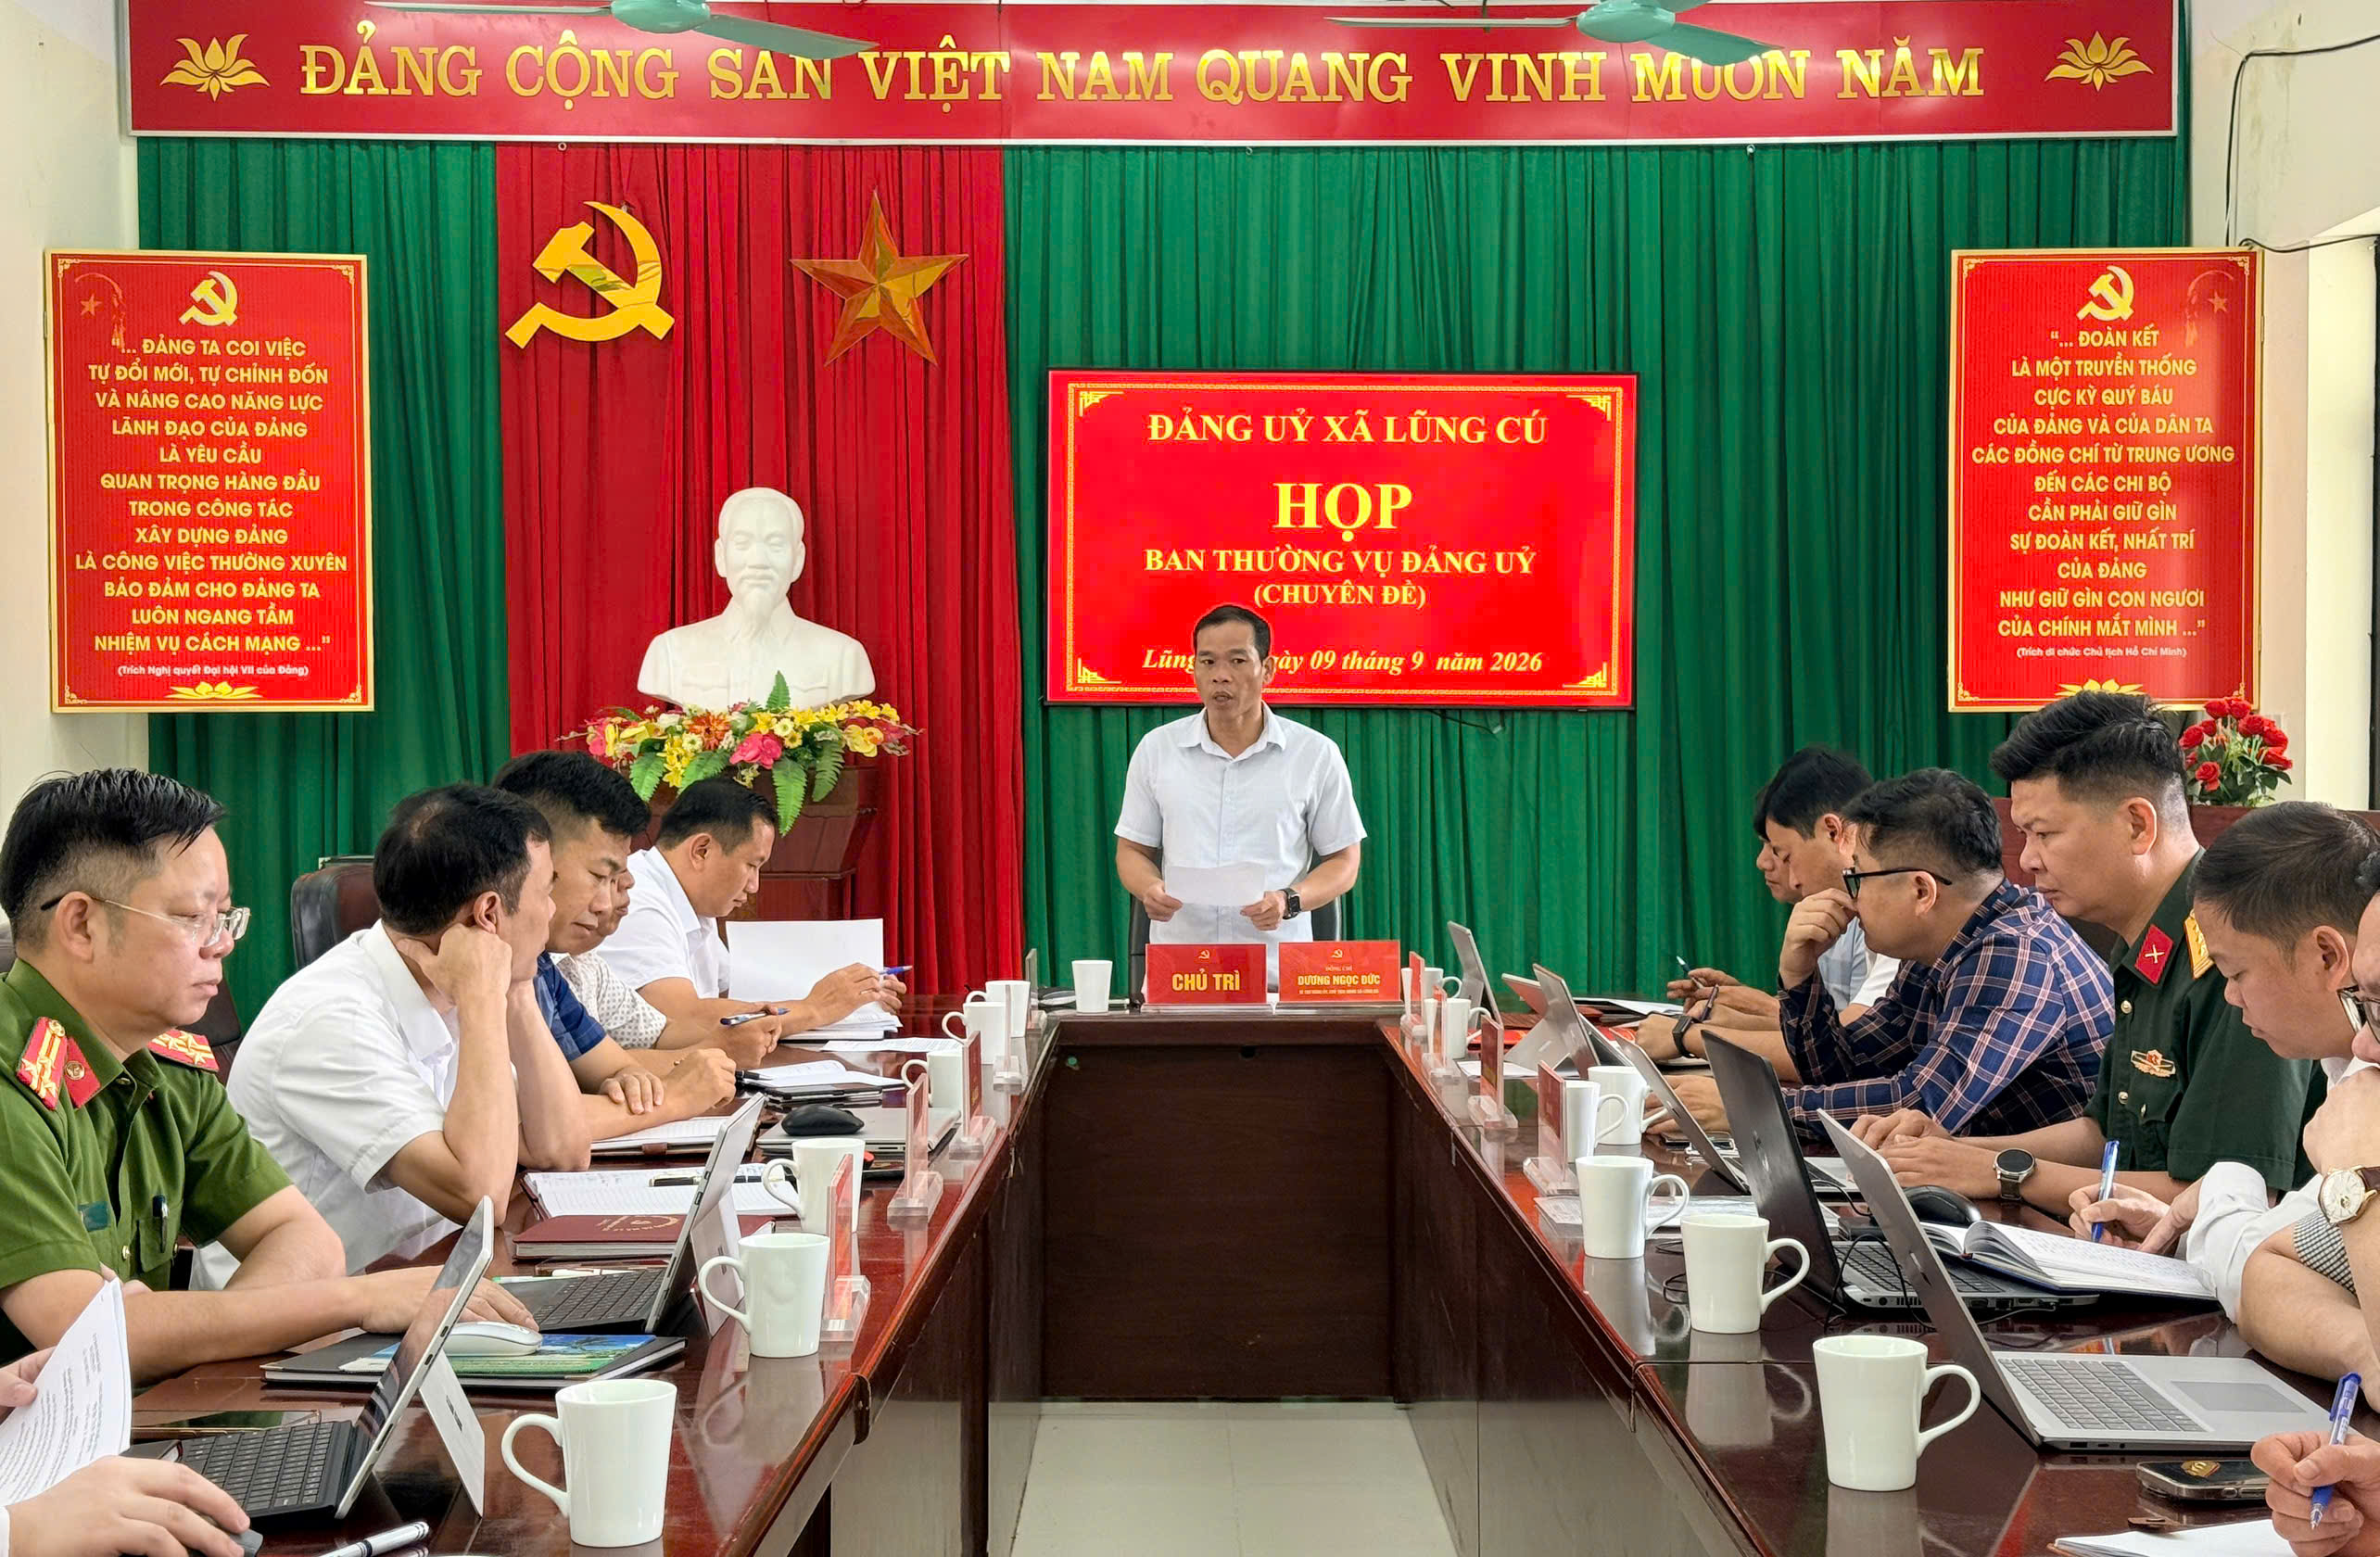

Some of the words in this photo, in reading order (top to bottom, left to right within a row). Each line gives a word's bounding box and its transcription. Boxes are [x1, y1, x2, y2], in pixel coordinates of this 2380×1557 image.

[299, 19, 483, 97] ĐẢNG
[506, 29, 678, 110] CỘNG
[858, 35, 1010, 113] VIỆT
[1036, 52, 1173, 101] NAM
[1196, 48, 1412, 106] QUANG
[1439, 52, 1607, 102] VINH
[1836, 36, 1984, 97] NĂM
[2079, 326, 2127, 347] ĐOÀN
[2133, 323, 2159, 347] KẾT
[142, 334, 196, 355] ĐẢNG
[200, 340, 221, 355] TA
[226, 341, 260, 356] COI
[265, 337, 305, 361] VIỆC
[89, 363, 110, 385] TỰ
[115, 358, 147, 381] ĐỔI
[154, 362, 193, 385] MỚI,
[199, 365, 221, 386] TỰ
[225, 363, 283, 383] CHỈNH
[288, 362, 327, 384] ĐỐN
[2012, 356, 2031, 376] LÀ
[2036, 356, 2071, 381] MỘT
[2076, 352, 2133, 376] TRUYỀN
[2139, 353, 2196, 375] THỐNG
[95, 388, 120, 407] VÀ
[127, 389, 179, 408] NÂNG
[185, 394, 225, 409] CAO
[232, 391, 284, 410] NĂNG
[290, 393, 323, 414] LỰC
[2034, 387, 2070, 410] CỰC
[2076, 385, 2097, 405] KỲ
[2102, 385, 2135, 405] QUÝ
[2141, 384, 2172, 405] BÁU
[113, 416, 158, 435] LÃNH
[164, 421, 205, 439] ĐẠO
[210, 416, 249, 437] CỦA
[255, 417, 308, 437] ĐẢNG
[1148, 407, 1253, 441] ĐẢNG
[1264, 408, 1313, 441] UỶ
[1323, 410, 1374, 441] XÃ
[1385, 410, 1486, 443] LŨNG
[1496, 410, 1546, 443] CÚ
[1994, 413, 2030, 435] CỦA
[2033, 412, 2082, 434] ĐẢNG
[2087, 413, 2110, 434] VÀ
[2115, 412, 2150, 434] CỦA
[2156, 413, 2190, 433] DÂN
[2195, 417, 2213, 433] TA
[160, 443, 181, 462] LÀ
[185, 444, 217, 463] YÊU
[223, 441, 261, 463] CẦU
[1972, 443, 2009, 463] CÁC
[2015, 439, 2064, 463] ĐỒNG
[2070, 443, 2099, 463] CHÍ
[2103, 443, 2123, 462] TỪ
[2127, 447, 2181, 462] TRUNG
[2185, 443, 2234, 462] ƯƠNG
[101, 474, 152, 489] QUAN
[158, 475, 219, 493] TRỌNG
[225, 471, 278, 490] HÀNG
[283, 469, 320, 490] ĐẦU
[2034, 469, 2066, 492] ĐẾN
[2071, 471, 2108, 492] CÁC
[2114, 475, 2143, 492] CHI
[2148, 472, 2171, 496] BỘ
[129, 501, 191, 516] TRONG
[196, 498, 252, 517] CÔNG
[258, 498, 293, 517] TÁC
[1273, 483, 1412, 541] HỌP
[2029, 497, 2065, 521] CẦN
[2070, 500, 2108, 521] PHẢI
[2113, 500, 2143, 521] GIỮ
[2146, 500, 2176, 520] GÌN
[135, 525, 171, 543] XÂY
[178, 526, 229, 548] DỰNG
[234, 524, 287, 544] ĐẢNG
[2010, 531, 2032, 554] SỰ
[2035, 529, 2083, 550] ĐOÀN
[2089, 527, 2118, 552] KẾT,
[2124, 526, 2167, 549] NHẤT
[2171, 529, 2195, 549] TRÍ
[76, 551, 96, 569] LÀ
[103, 551, 158, 570] CÔNG
[164, 551, 205, 575] VIỆC
[209, 551, 285, 571] THƯỜNG
[291, 552, 347, 571] XUYÊN
[1146, 550, 1205, 571] BAN
[1213, 544, 1344, 572] THƯỜNG
[1351, 551, 1393, 578] VỤ
[1401, 545, 1487, 573] ĐẢNG
[1496, 546, 1536, 574] UỶ
[2057, 557, 2093, 578] CỦA
[2098, 557, 2147, 578] ĐẢNG
[105, 576, 143, 597] BẢO
[148, 576, 189, 597] ĐẢM
[196, 582, 237, 598] CHO
[242, 577, 295, 598] ĐẢNG
[299, 583, 320, 598] TA
[1255, 579, 1374, 608] (CHUYÊN
[1382, 580, 1425, 609] ĐỀ)
[2000, 589, 2035, 607] NHƯ
[2039, 588, 2069, 608] GIỮ
[2072, 587, 2102, 607] GÌN
[2108, 590, 2145, 607] CON
[133, 605, 178, 624] LUÔN
[185, 609, 252, 625] NGANG
[257, 602, 293, 625] TẦM
[1998, 614, 2033, 636] CỦA
[2039, 615, 2091, 636] CHÍNH
[2096, 613, 2131, 636] MẮT
[2135, 615, 2177, 636] MÌNH
[95, 632, 150, 655] NHIỆM
[156, 636, 180, 655] VỤ
[185, 632, 239, 651] CÁCH
[246, 636, 300, 655] MẠNG
[1310, 651, 1336, 669] 09
[1342, 651, 1405, 675] tháng
[1412, 652, 1424, 670] 9
[1437, 652, 1483, 670] năm
[1490, 652, 1542, 671] 2026
[1172, 968, 1207, 991] CHỦ
[1212, 970, 1239, 990] TRÌ
[1298, 975, 1330, 985] DƯƠNG
[1333, 975, 1359, 986] NGỌC
[1361, 973, 1380, 984] ĐỨC
